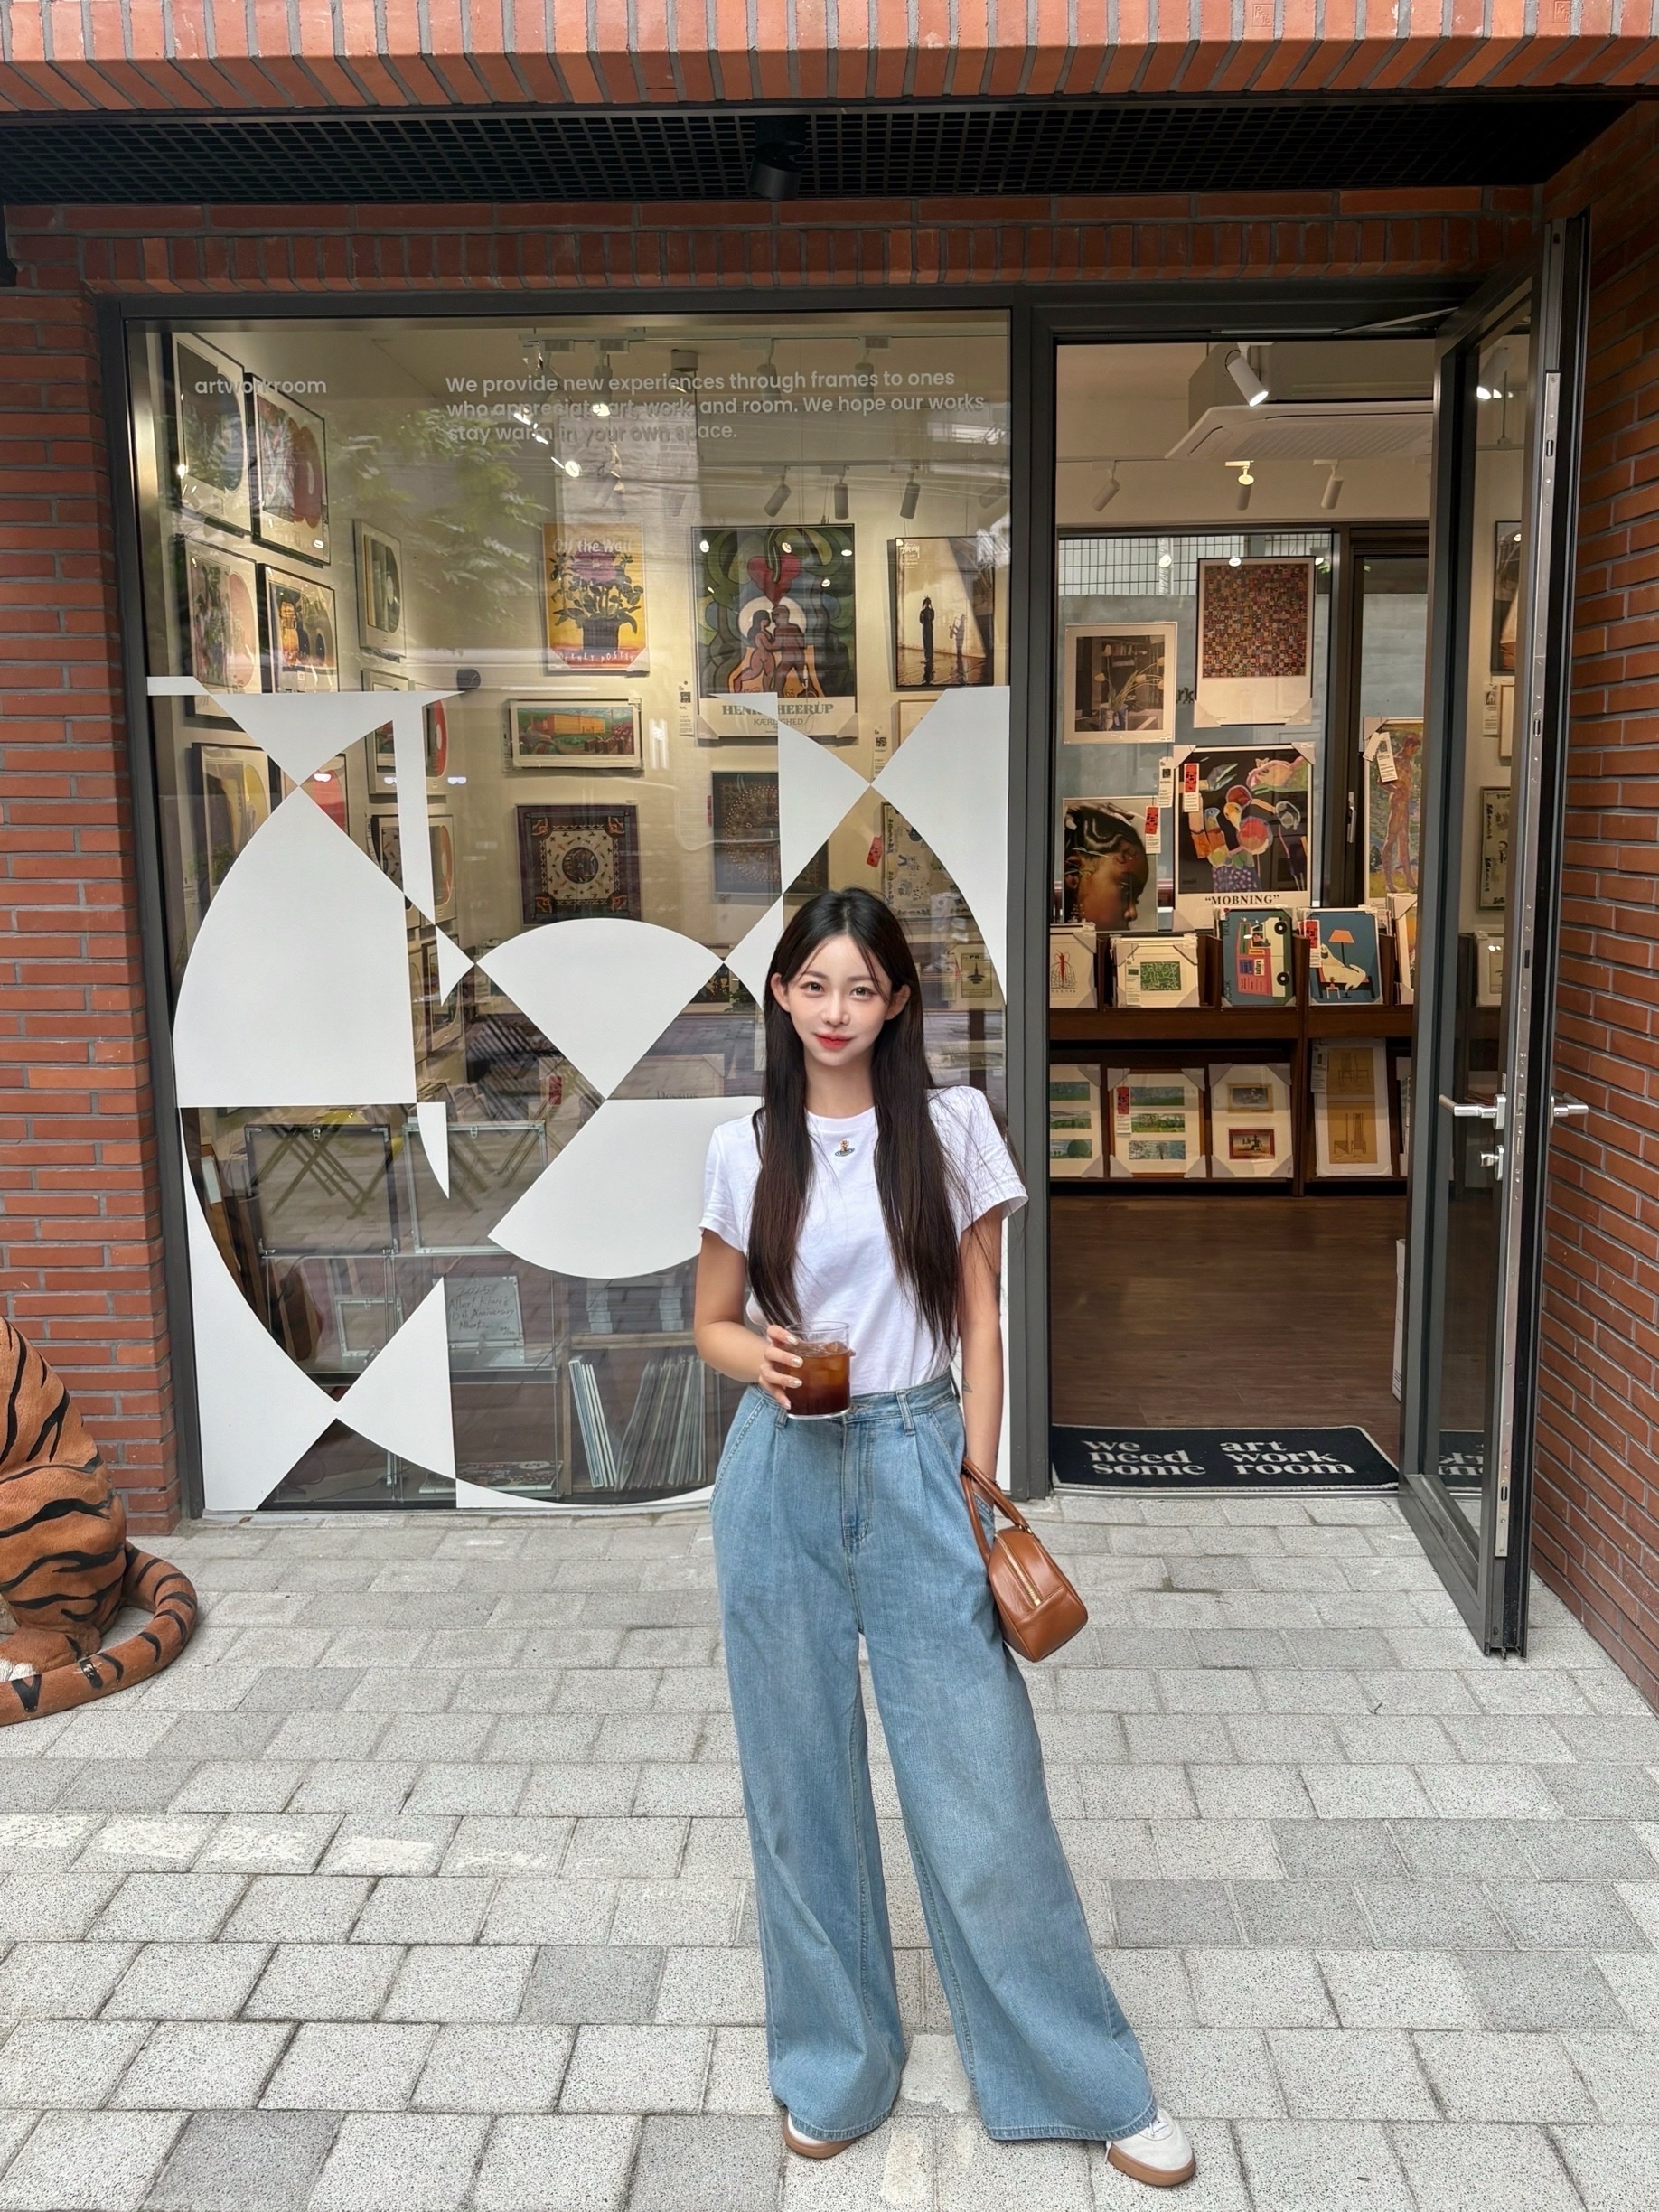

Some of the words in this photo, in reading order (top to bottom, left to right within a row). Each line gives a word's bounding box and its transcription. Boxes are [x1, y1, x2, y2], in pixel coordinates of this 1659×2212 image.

[194, 378, 327, 394] artworkroom
[445, 377, 477, 392] We
[483, 375, 558, 397] provide
[563, 378, 604, 391] new
[608, 373, 724, 395] experiences
[729, 371, 806, 393] through
[811, 371, 878, 388] frames
[883, 371, 903, 386] to
[907, 371, 955, 386] ones
[446, 400, 488, 417] who
[699, 398, 737, 414] and
[742, 398, 798, 414] room.
[802, 397, 833, 412] We
[838, 395, 886, 416] hope
[890, 398, 923, 411] our
[928, 394, 985, 411] works
[448, 426, 491, 445] stay
[495, 426, 553, 441] warm
[560, 426, 577, 443] in
[582, 427, 627, 446] your
[629, 426, 671, 442] own
[674, 425, 737, 445] space.
[577, 538, 601, 553] the
[778, 703, 834, 716] HEERUP
[1081, 1440, 1141, 1452] we
[1220, 1440, 1288, 1452] art
[1088, 1449, 1192, 1463] need
[1223, 1449, 1341, 1463] work
[1092, 1463, 1206, 1476] some
[1233, 1463, 1357, 1475] room
